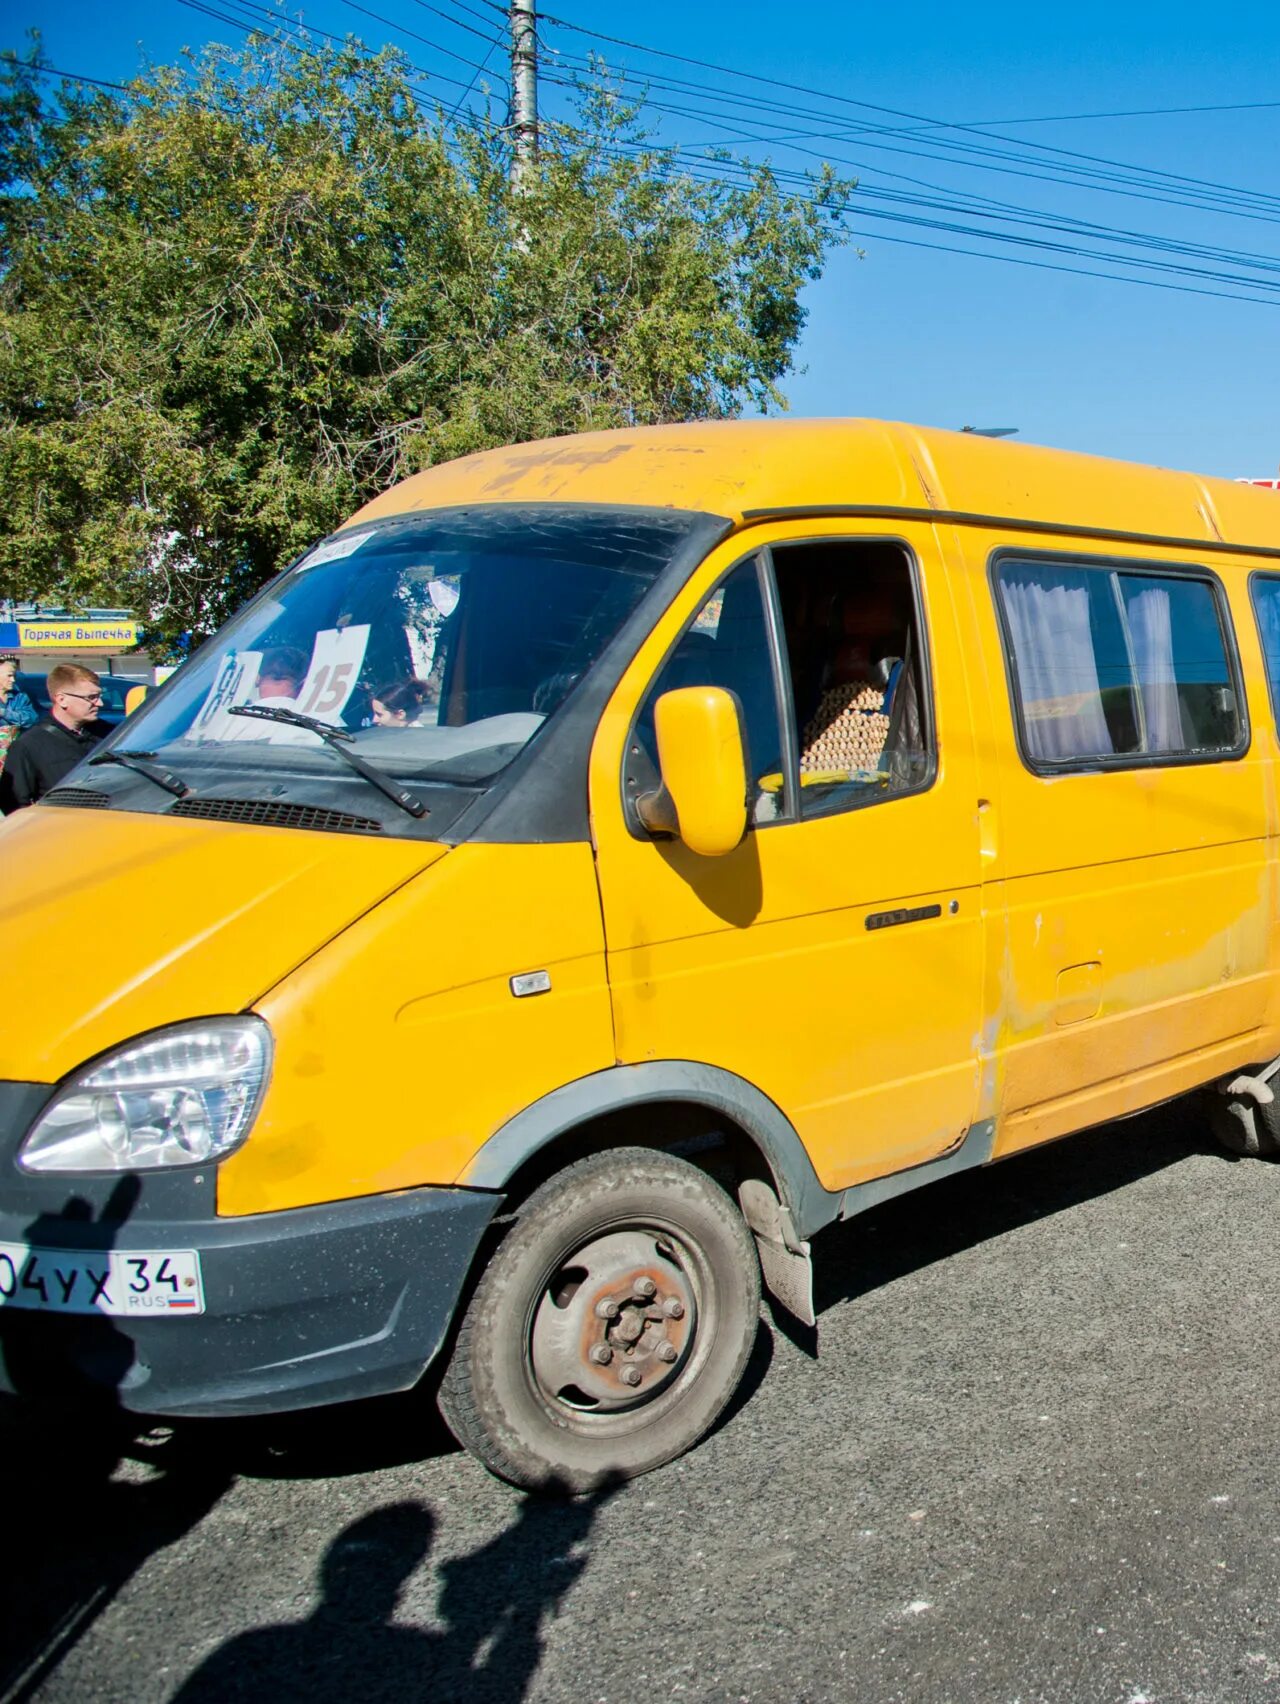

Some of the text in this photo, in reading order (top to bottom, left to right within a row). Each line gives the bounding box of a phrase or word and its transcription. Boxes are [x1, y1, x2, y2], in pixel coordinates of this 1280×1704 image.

[24, 628, 131, 641] Горячая Выпечка
[301, 662, 354, 714] 15
[127, 1257, 179, 1293] 34
[128, 1296, 166, 1308] RUS
